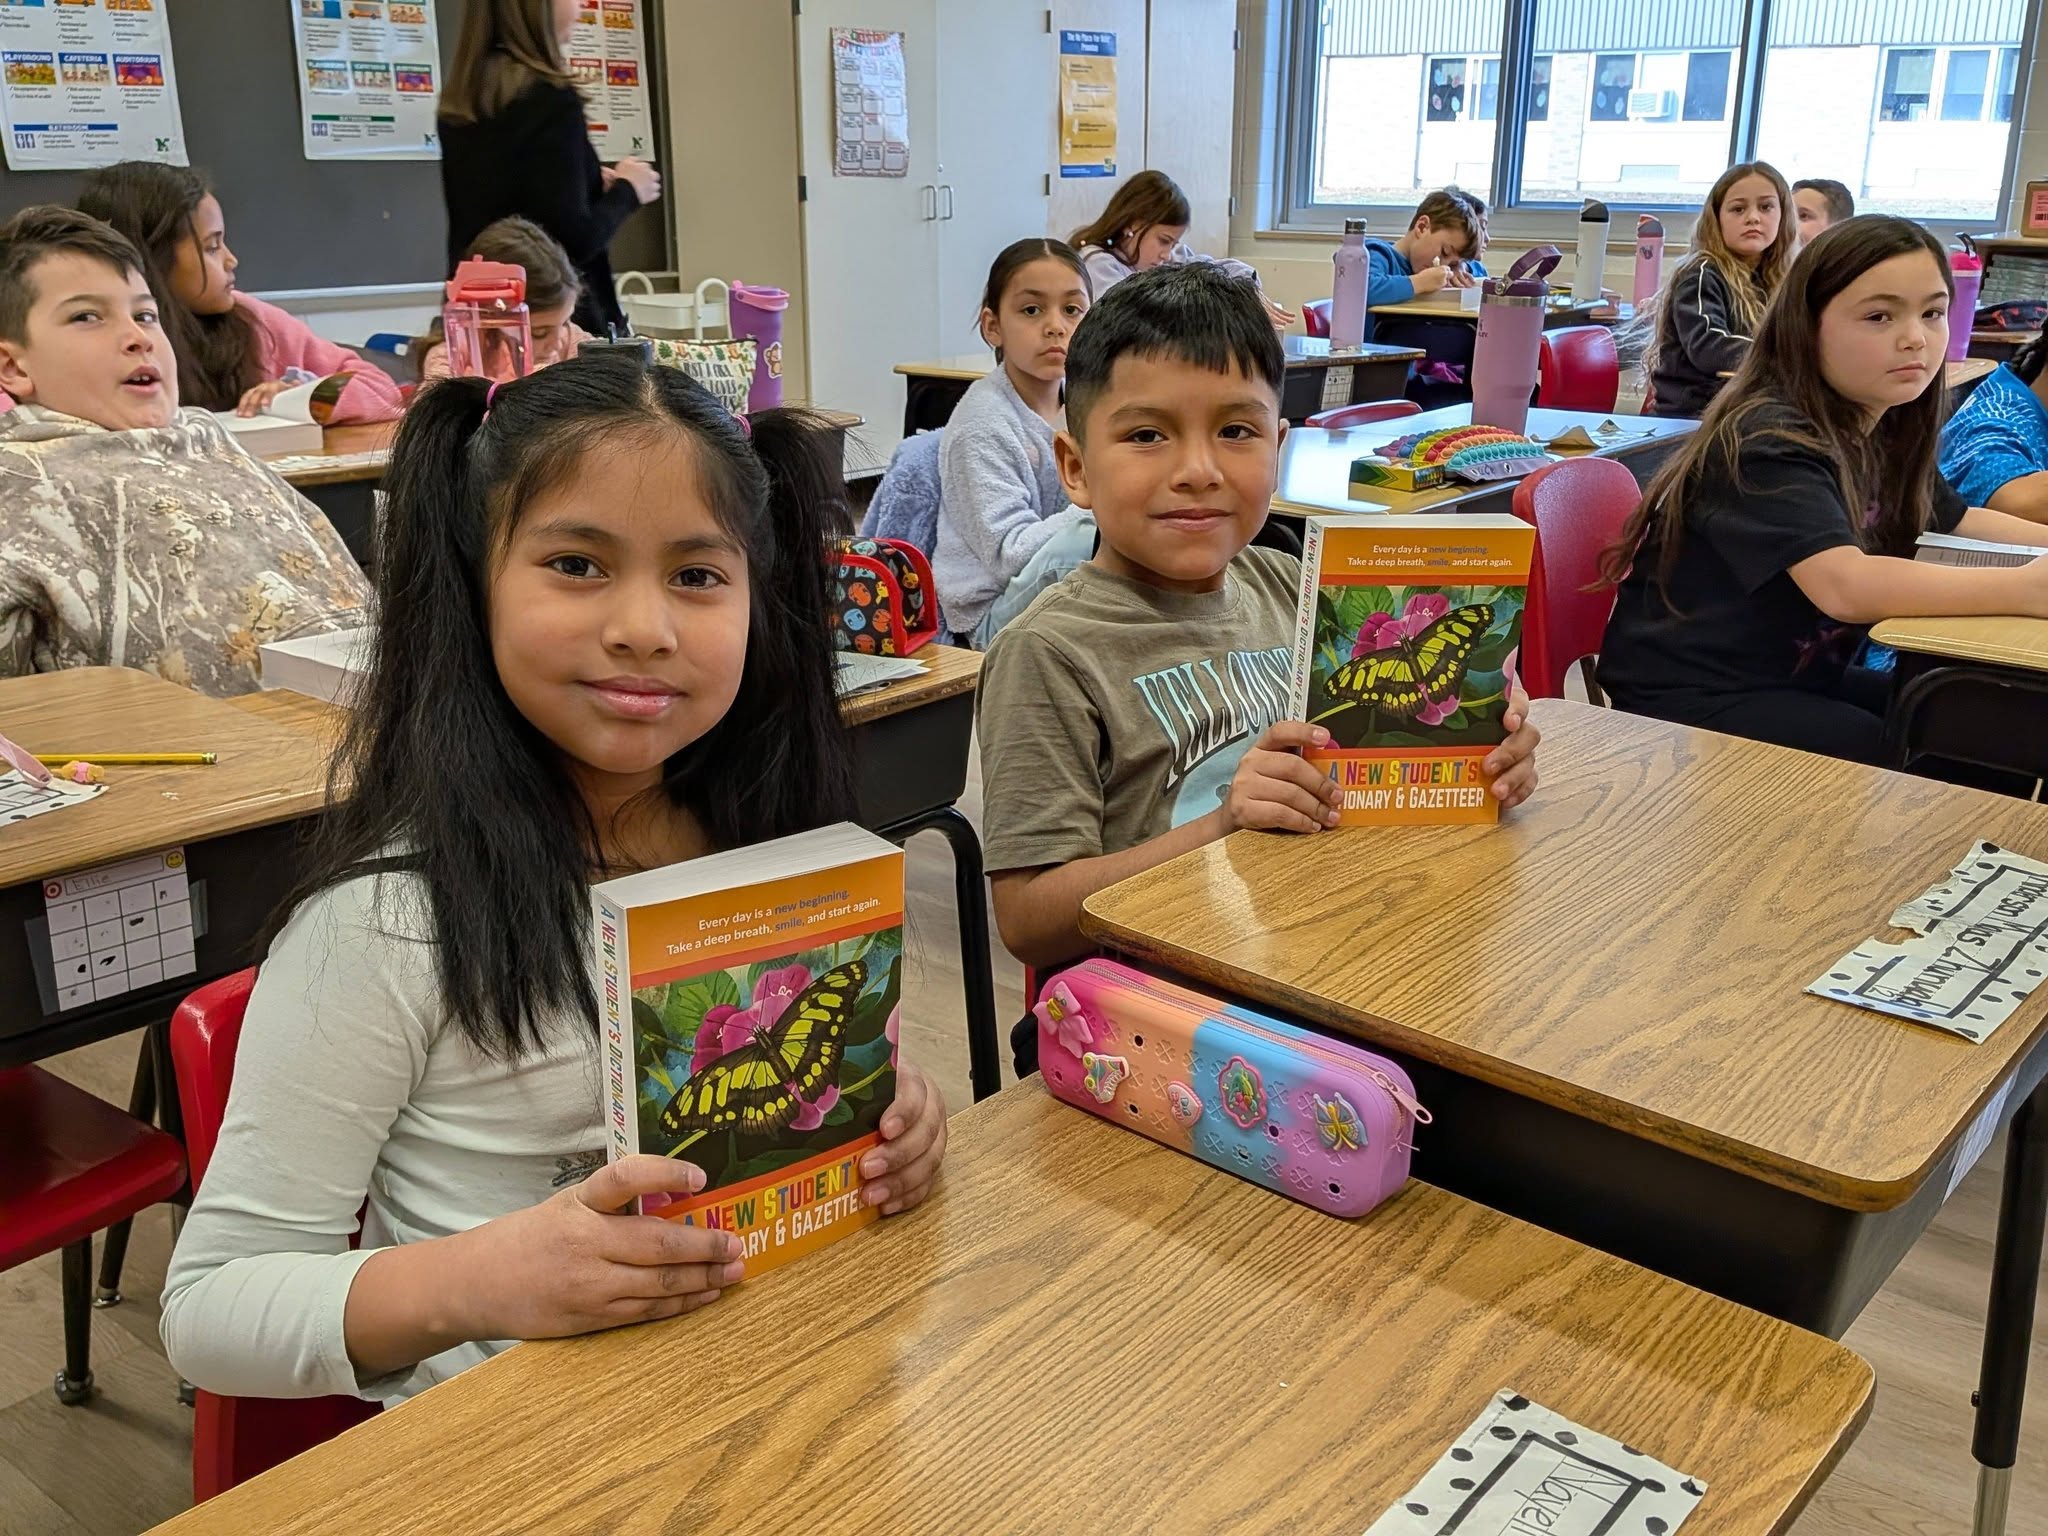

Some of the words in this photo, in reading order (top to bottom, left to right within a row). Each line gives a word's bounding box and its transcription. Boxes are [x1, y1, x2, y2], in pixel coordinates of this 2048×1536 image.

[4, 53, 52, 62] PLAYGROUND
[1310, 525, 1318, 535] A
[1373, 545, 1396, 555] Every
[1397, 545, 1413, 555] day
[1414, 545, 1421, 553] is
[1307, 537, 1317, 565] NEW
[1347, 558, 1367, 566] Take
[1375, 558, 1396, 567] deep
[1397, 558, 1426, 567] breath,
[1452, 558, 1467, 566] and
[1469, 558, 1488, 566] start
[1489, 558, 1513, 567] again.
[1301, 565, 1314, 626] STUDENT'S
[1295, 626, 1309, 690] DICTIONARY
[1329, 761, 1339, 783] A
[1345, 760, 1384, 786] NEW
[1389, 758, 1479, 785] STUDENT'S
[1338, 788, 1392, 810] IONARY
[1395, 787, 1405, 809] &
[1409, 786, 1485, 809] GAZETTEER
[600, 904, 616, 920] A
[666, 940, 692, 955] Take
[694, 941, 702, 950] a
[704, 932, 731, 948] deep
[734, 924, 773, 940] breath,
[775, 918, 805, 932] smile,
[807, 910, 826, 924] and
[828, 904, 852, 919] start
[853, 897, 881, 914] again.
[698, 915, 731, 932] Every
[732, 910, 752, 925] day
[754, 908, 763, 919] is
[765, 908, 773, 917] a
[774, 903, 798, 915] new
[799, 890, 850, 909] beginning.
[601, 920, 617, 961] NEW
[604, 961, 622, 1042] STUDENT'S
[608, 1042, 626, 1132] DICTIONARY
[705, 1198, 756, 1232] NEW
[764, 1154, 860, 1221] STUDENT'
[775, 1217, 786, 1246] &
[791, 1187, 864, 1240] GAZETTE
